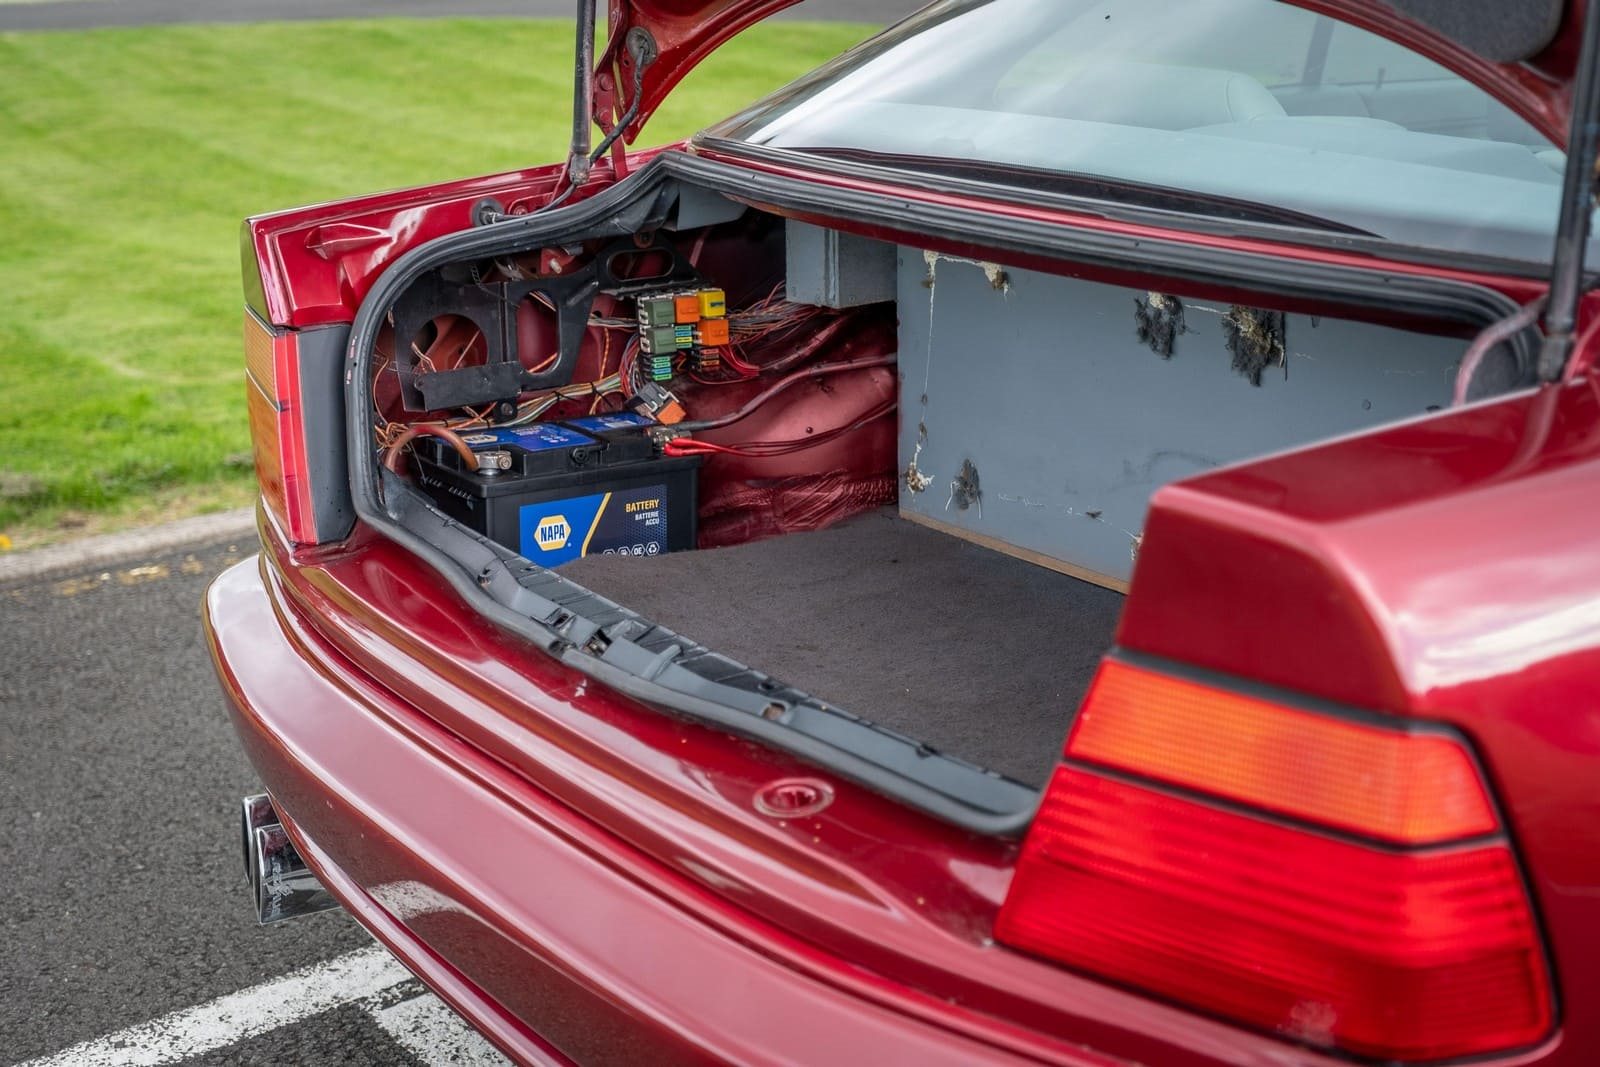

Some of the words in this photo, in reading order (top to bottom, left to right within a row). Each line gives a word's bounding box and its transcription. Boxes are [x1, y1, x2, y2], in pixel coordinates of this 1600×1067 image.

[625, 499, 660, 512] BATTERY
[635, 511, 659, 520] BATTERIE
[645, 518, 660, 526] ACCU
[540, 523, 565, 542] NAPA
